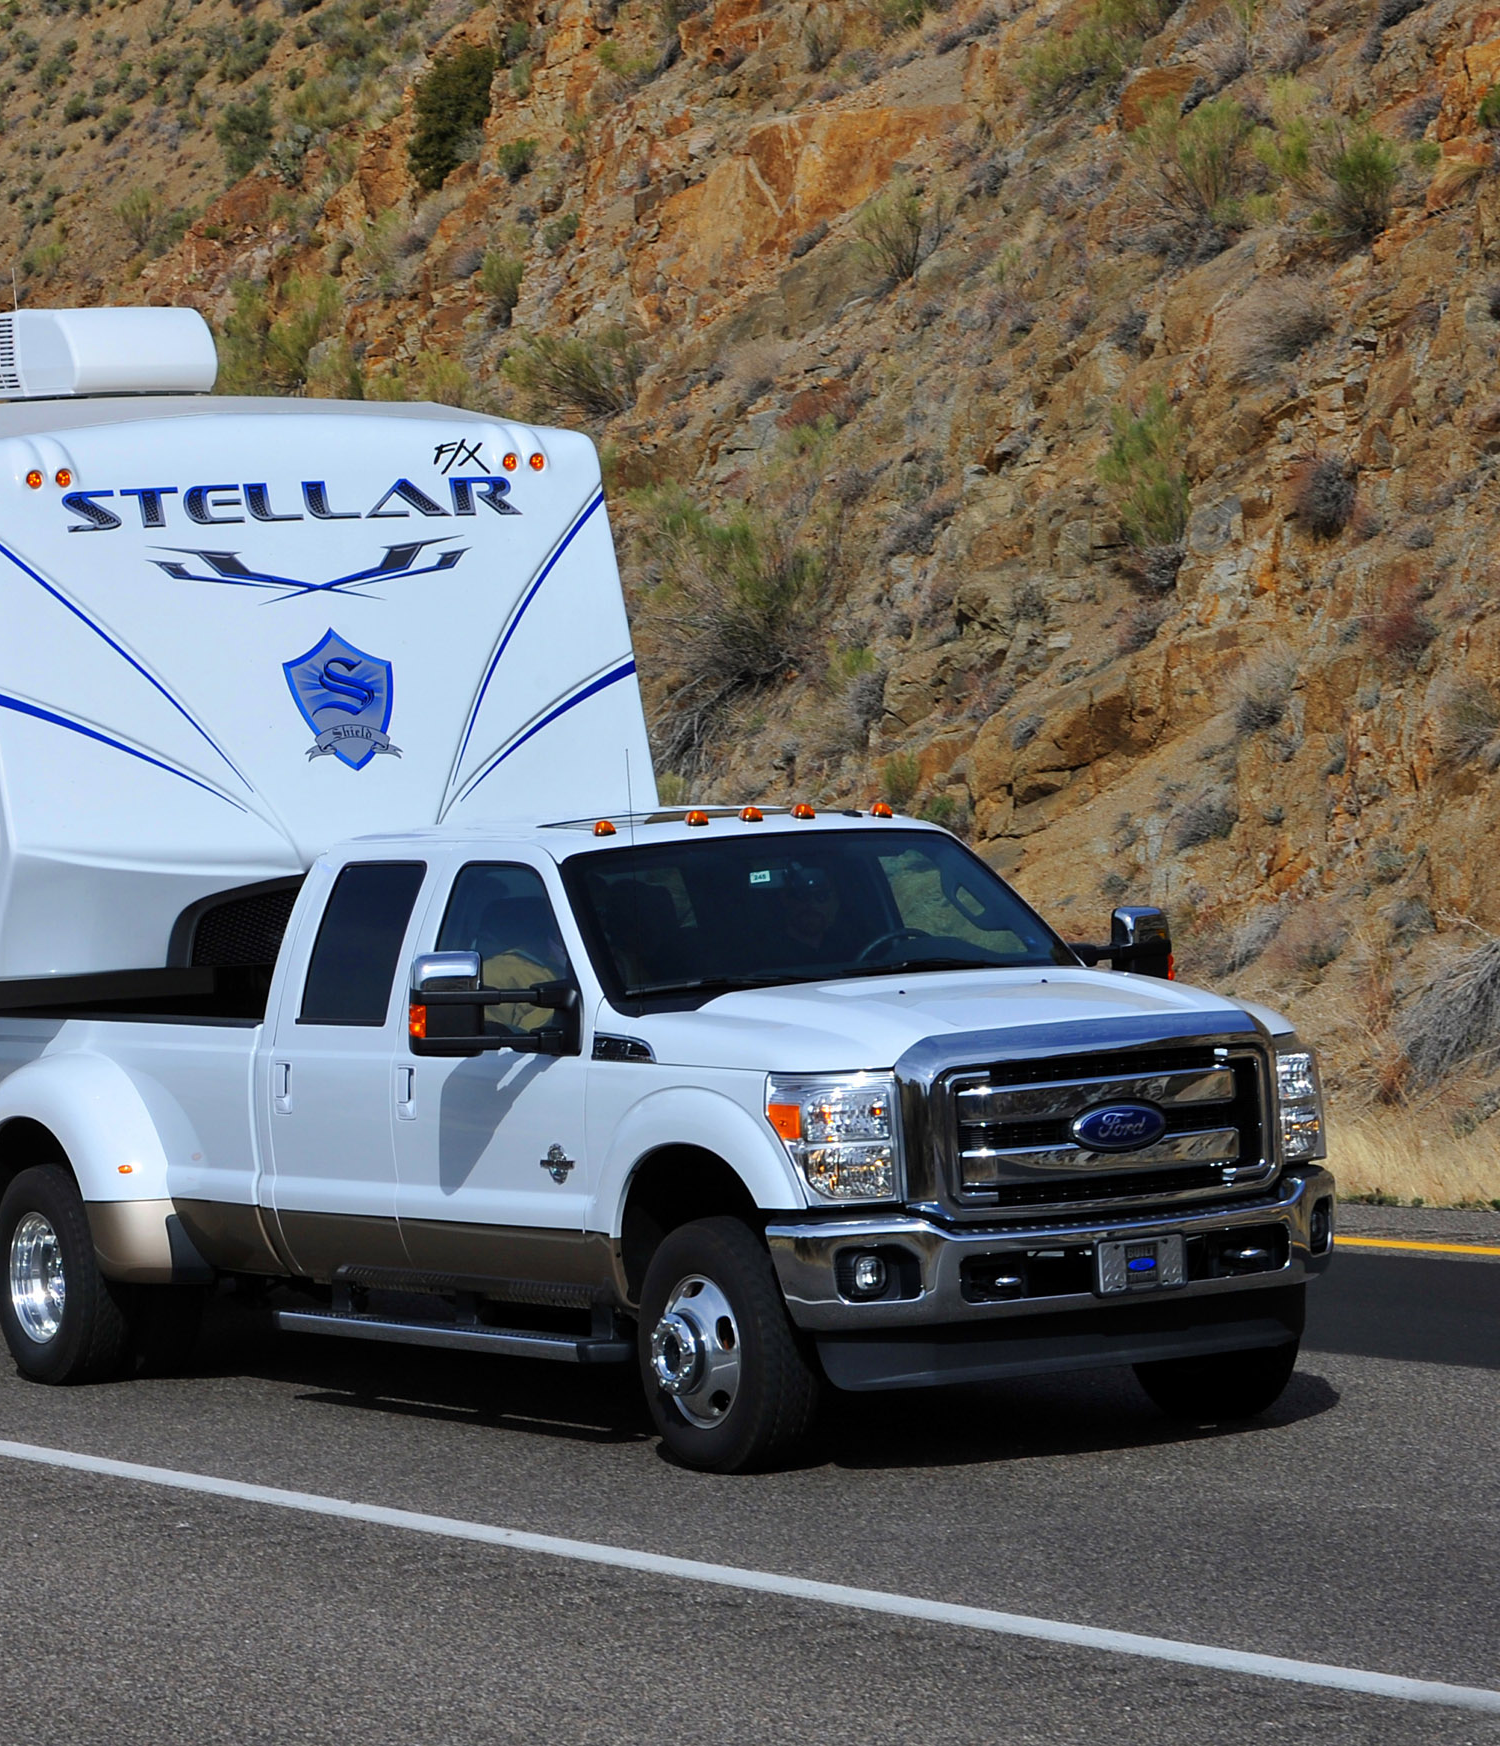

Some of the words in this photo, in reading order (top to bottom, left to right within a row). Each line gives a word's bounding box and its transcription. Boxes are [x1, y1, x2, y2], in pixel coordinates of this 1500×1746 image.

[433, 438, 491, 475] F/X
[61, 476, 523, 533] STELLAR
[332, 726, 373, 739] Shield
[1098, 1112, 1146, 1138] Ford
